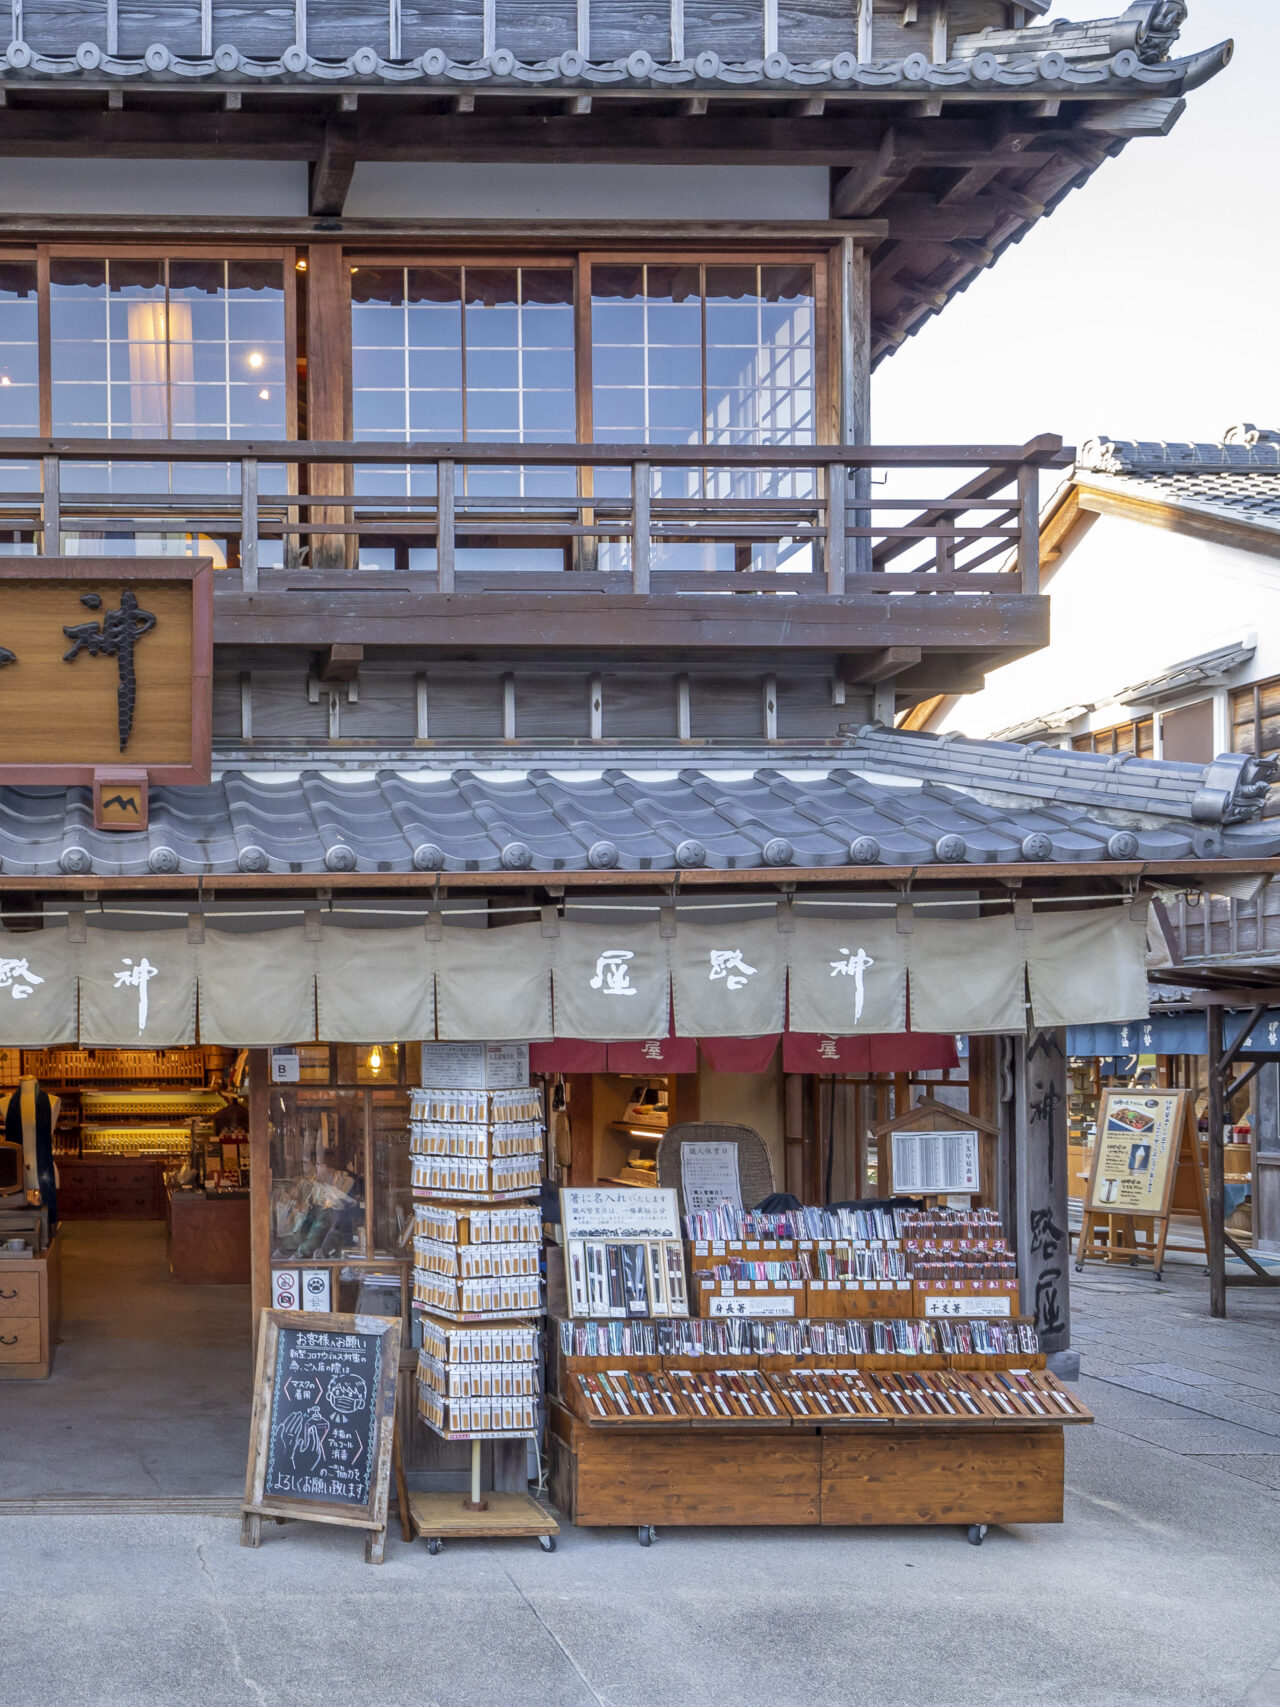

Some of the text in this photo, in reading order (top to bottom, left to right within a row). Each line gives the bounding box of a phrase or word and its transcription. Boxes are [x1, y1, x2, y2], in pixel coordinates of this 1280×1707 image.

[641, 1039, 665, 1060] 屋
[817, 1035, 840, 1060] 屋
[296, 1331, 367, 1349] お客様へお願い
[291, 1380, 316, 1389] マスクの
[328, 1439, 354, 1448] アルコール
